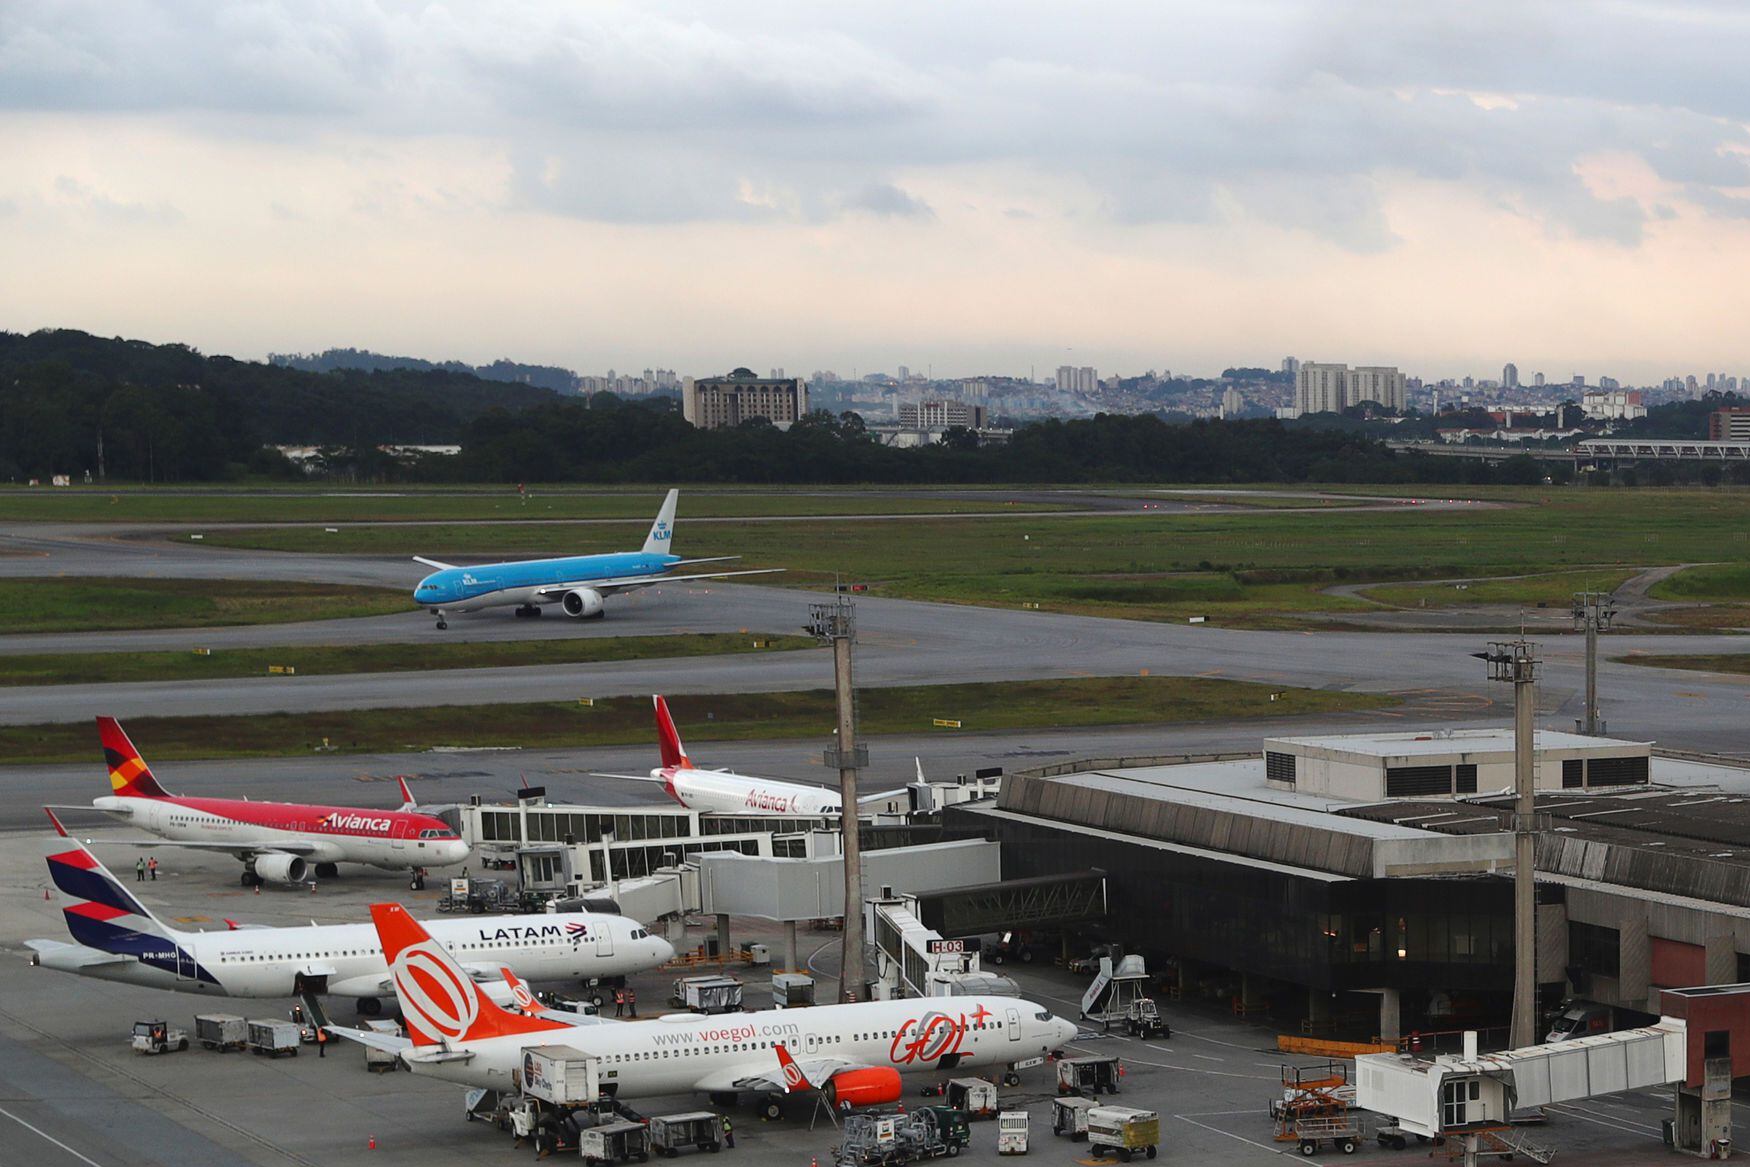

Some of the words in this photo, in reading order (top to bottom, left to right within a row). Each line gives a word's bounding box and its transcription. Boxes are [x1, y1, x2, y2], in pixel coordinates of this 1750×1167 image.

[653, 530, 671, 541] KLM
[746, 788, 787, 812] Avianca
[324, 812, 392, 831] Avianca
[479, 926, 562, 941] LATAM
[652, 1020, 799, 1046] www.voegol.com
